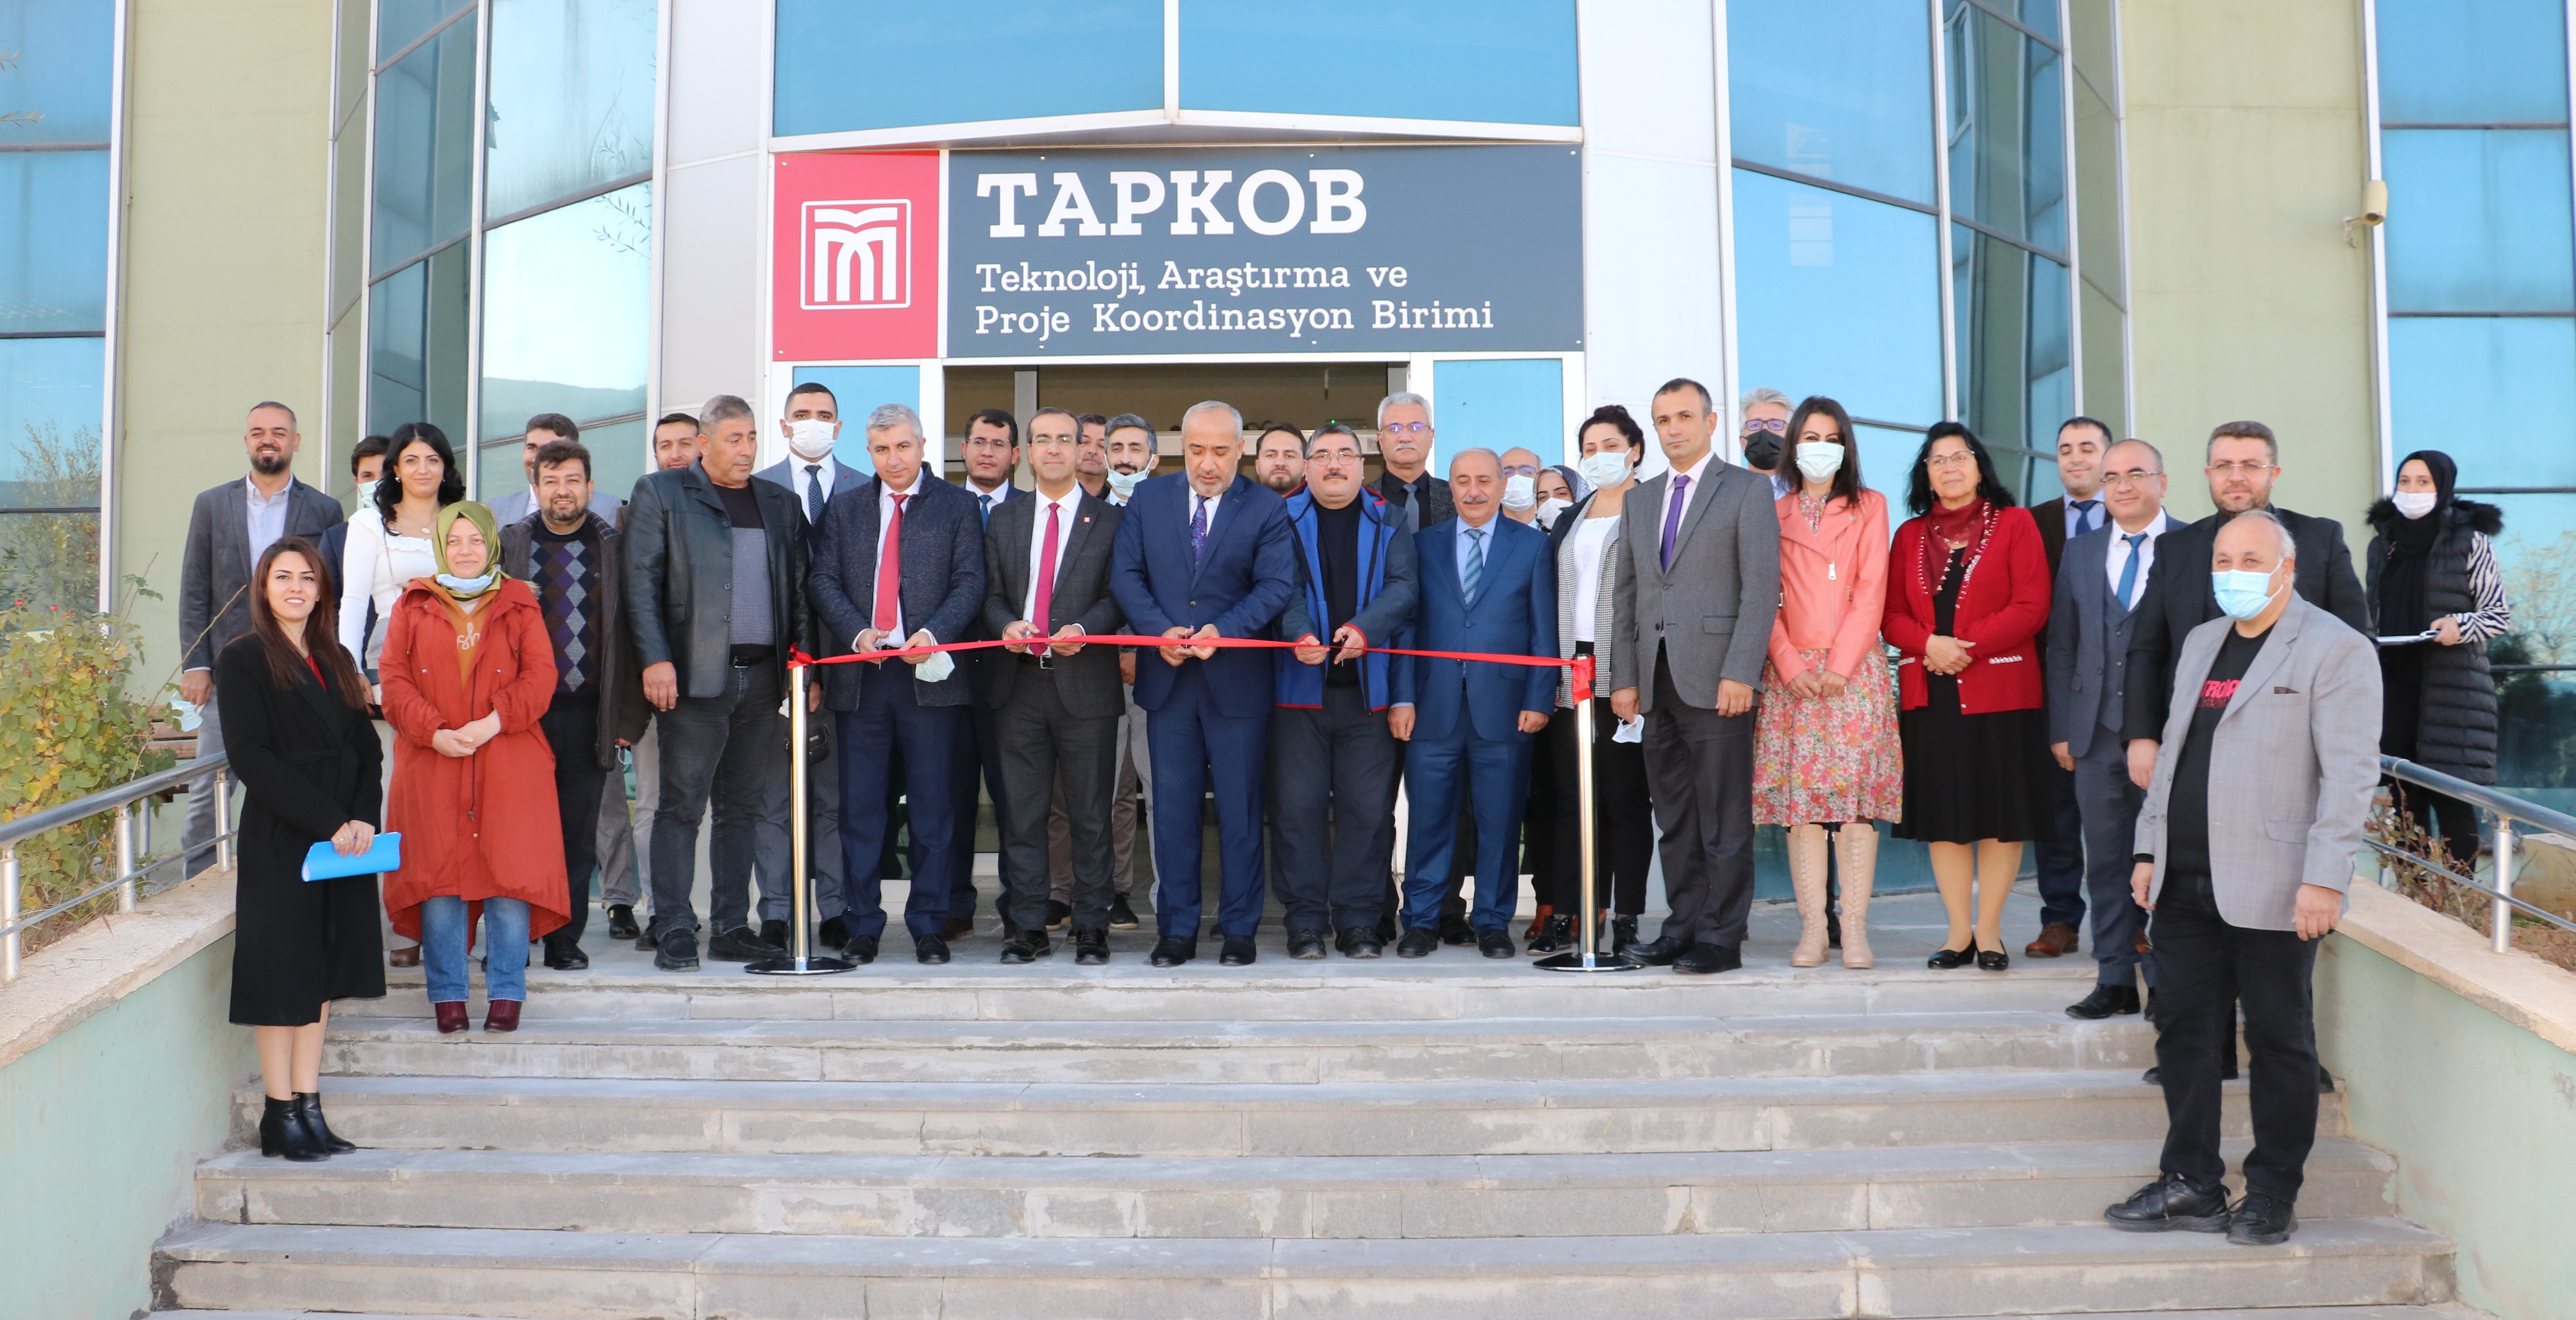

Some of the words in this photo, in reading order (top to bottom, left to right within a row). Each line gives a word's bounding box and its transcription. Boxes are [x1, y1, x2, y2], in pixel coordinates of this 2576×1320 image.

[976, 169, 1367, 238] TAPKOB
[975, 260, 1146, 299] Teknoloji,
[1157, 260, 1351, 297] Araştırma
[1366, 266, 1408, 287] ve
[975, 305, 1070, 342] Proje
[1093, 300, 1355, 338] Koordinasyon
[1372, 300, 1494, 329] Birimi
